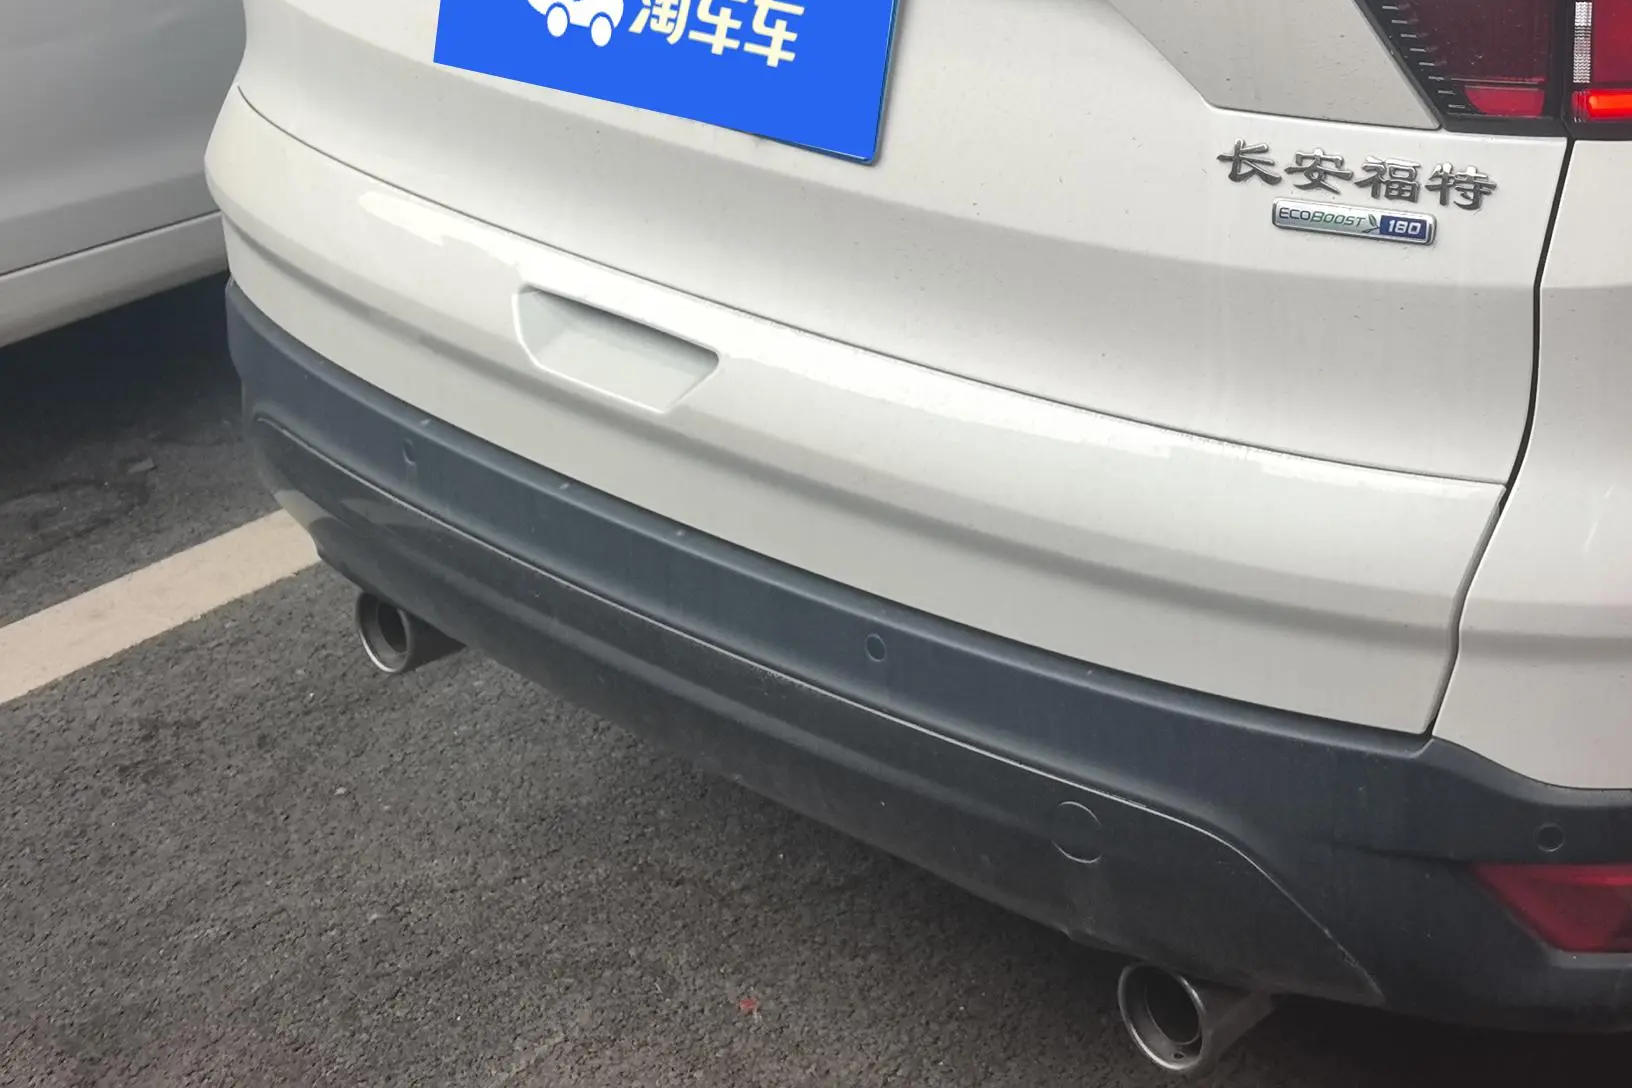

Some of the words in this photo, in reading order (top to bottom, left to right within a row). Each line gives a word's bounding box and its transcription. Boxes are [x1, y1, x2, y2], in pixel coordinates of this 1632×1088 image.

[1216, 137, 1498, 210] 长安福特
[1278, 206, 1366, 227] ECOBOOST
[1387, 218, 1422, 236] 180
